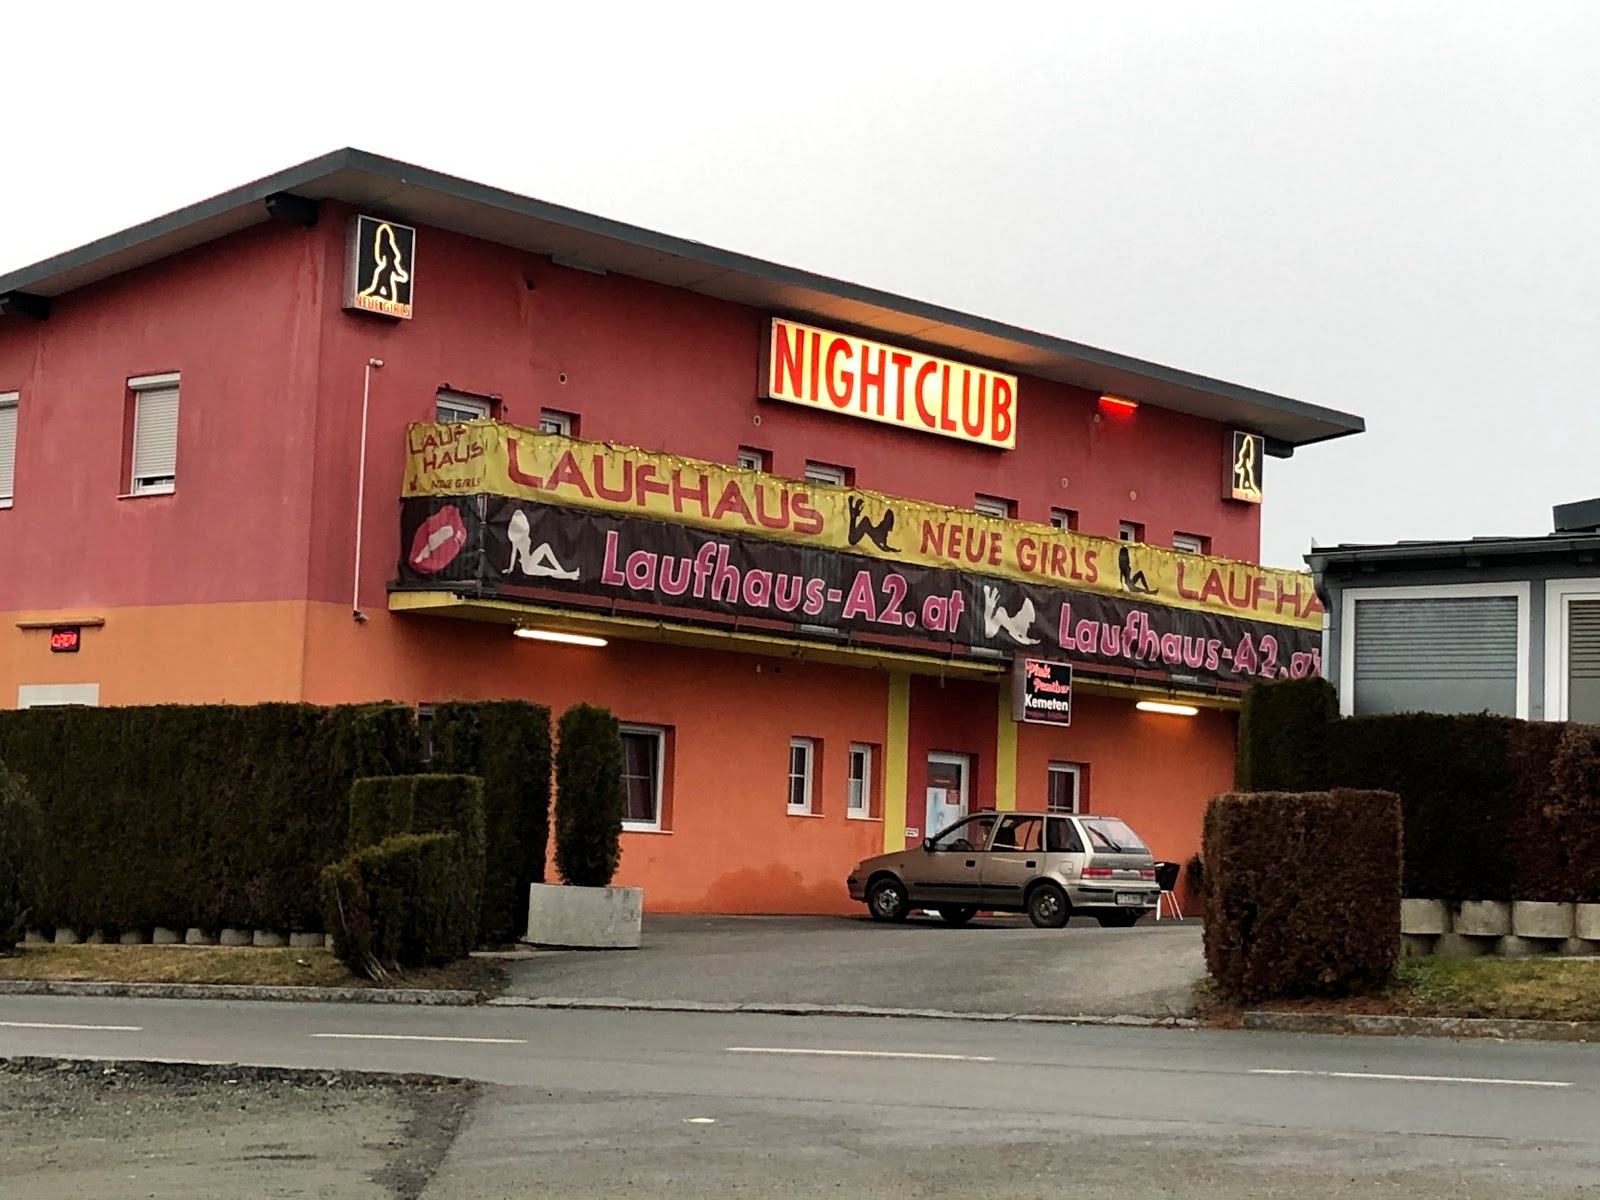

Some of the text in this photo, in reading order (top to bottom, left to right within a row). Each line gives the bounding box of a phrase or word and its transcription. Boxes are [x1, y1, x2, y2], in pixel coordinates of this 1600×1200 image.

[774, 323, 1012, 442] NIGHTCLUB
[409, 424, 467, 455] LAUF
[423, 441, 484, 474] HAUS
[454, 477, 481, 489] GIRLS
[507, 437, 824, 535] LAUFHAUS
[920, 519, 1099, 583] NEUE GIRLS
[600, 529, 965, 633] Laufhaus-A2.at
[1025, 694, 1069, 712] Kemeten
